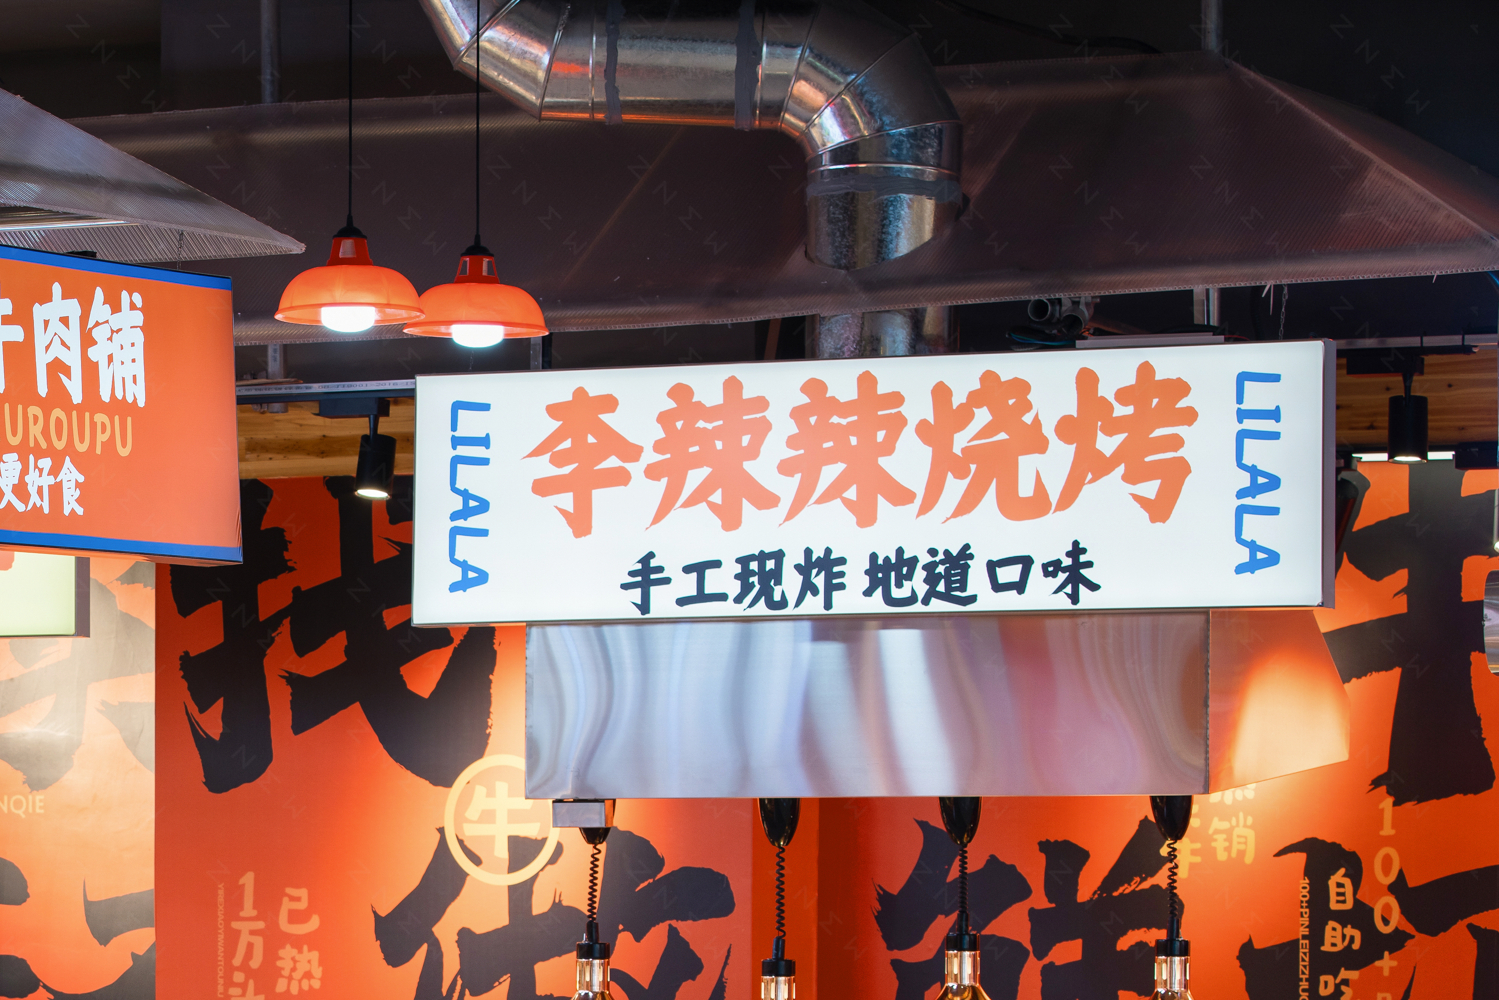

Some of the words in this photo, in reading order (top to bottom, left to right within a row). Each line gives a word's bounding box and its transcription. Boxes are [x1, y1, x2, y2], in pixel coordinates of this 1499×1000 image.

[450, 399, 492, 594] LILALA
[521, 360, 1199, 538] 李辣辣烧烤
[1234, 370, 1282, 576] LILALA
[620, 547, 847, 614] 手工现炸
[862, 539, 1102, 607] 地道口味
[463, 780, 543, 859] 牛
